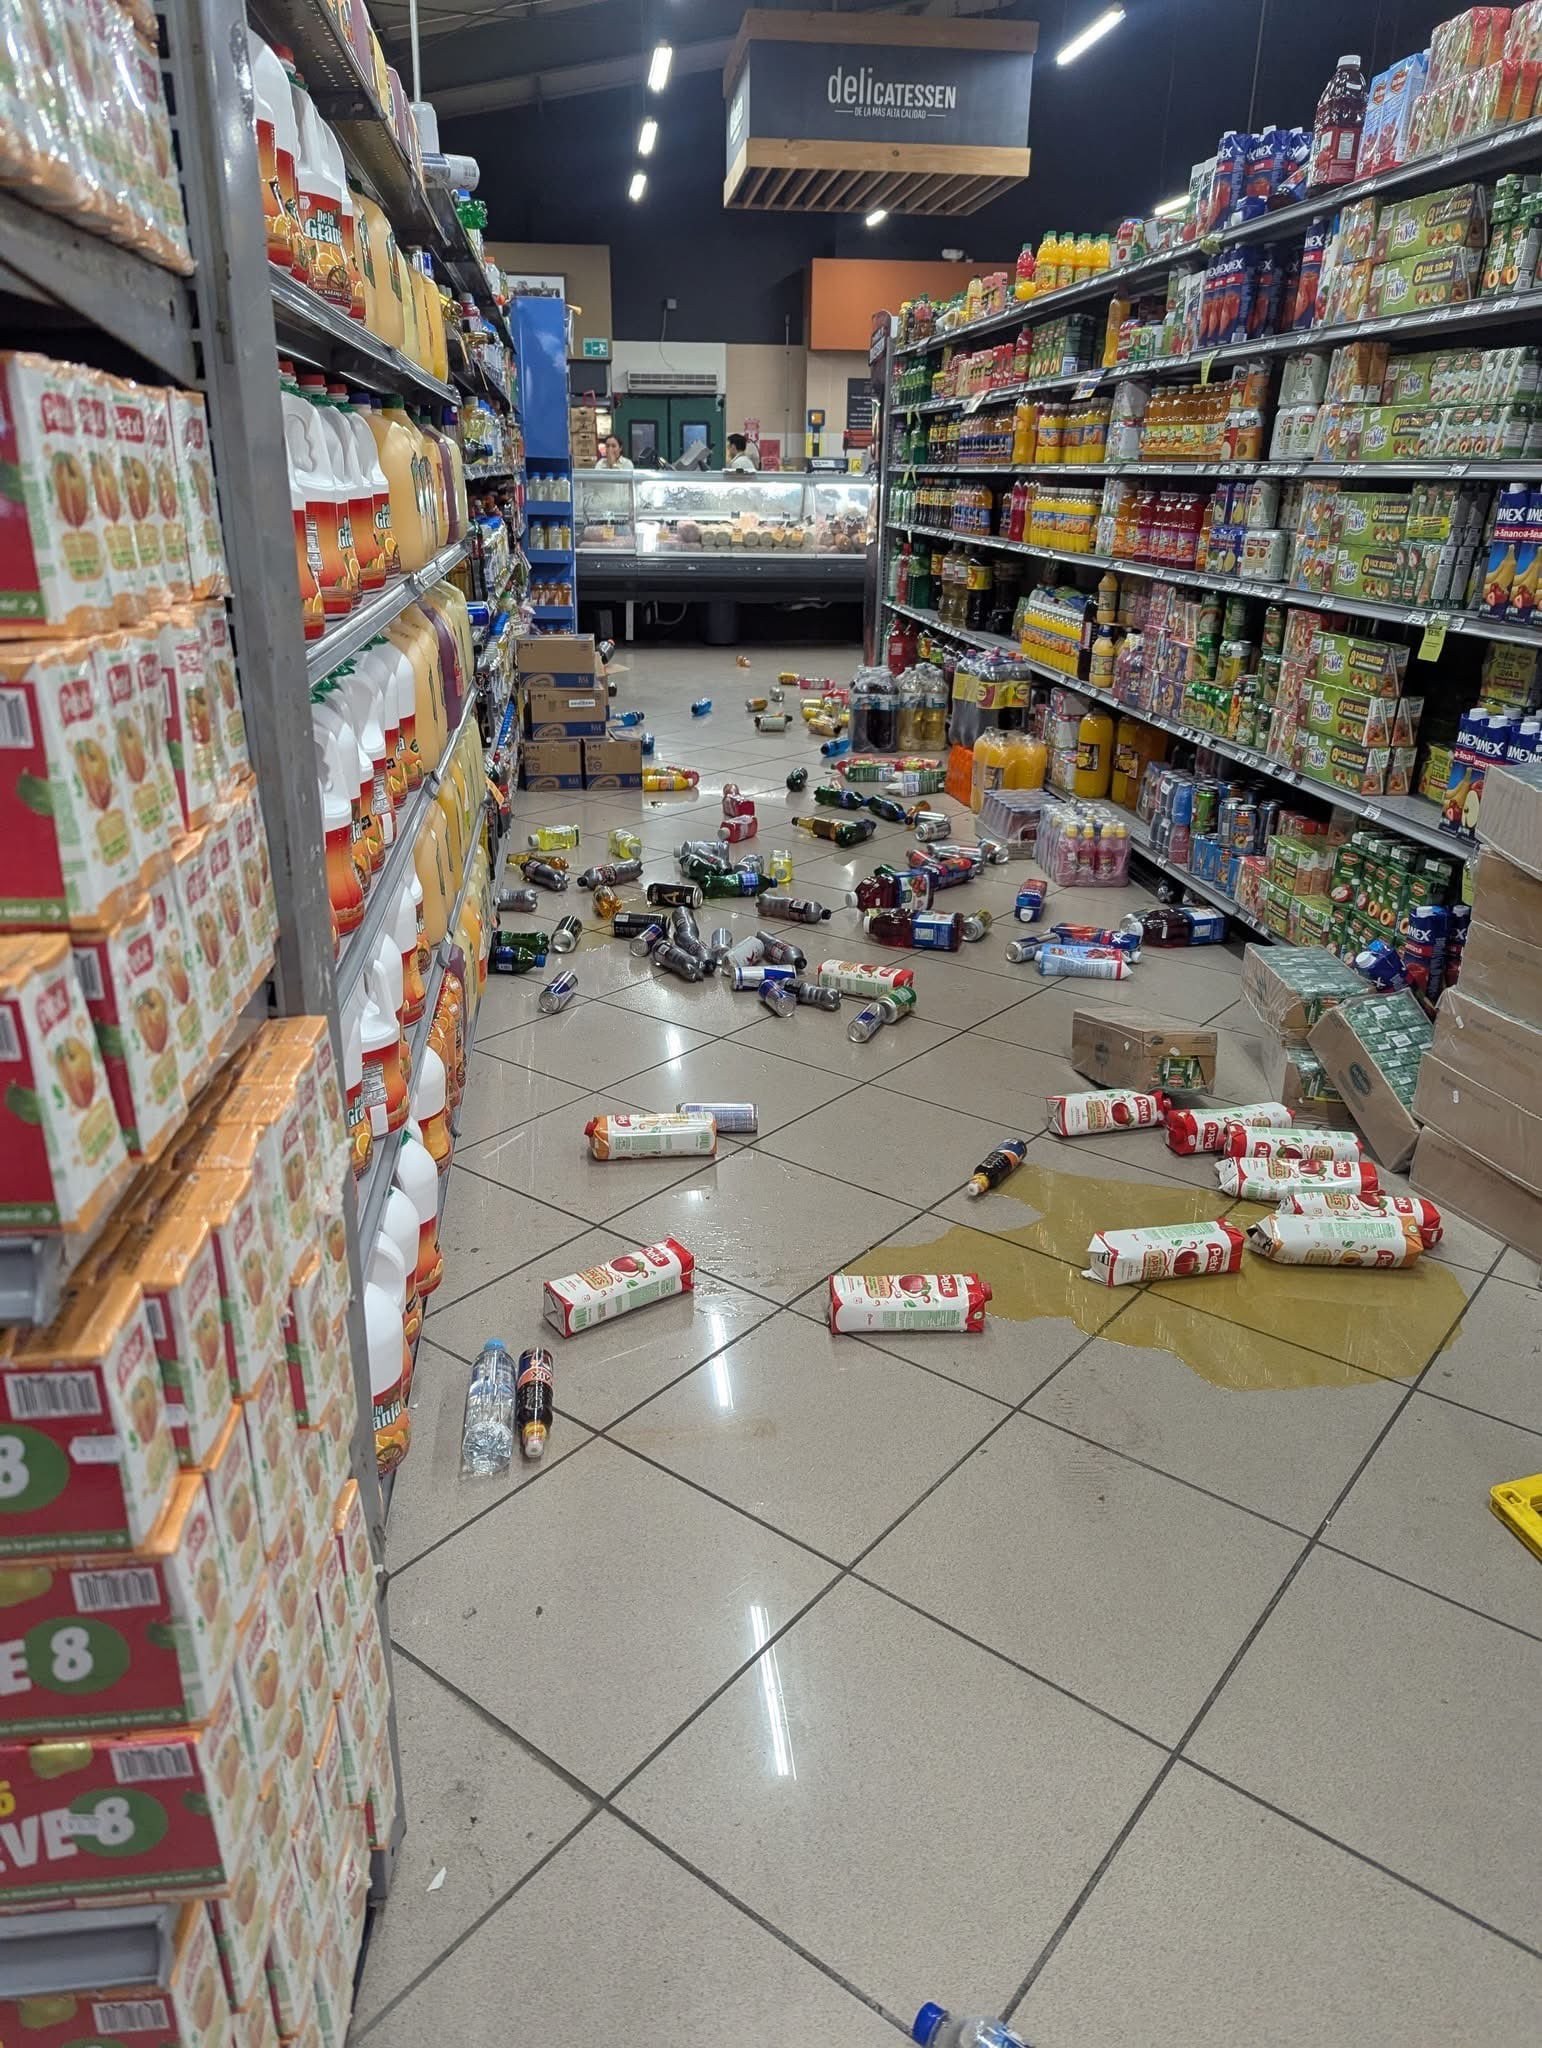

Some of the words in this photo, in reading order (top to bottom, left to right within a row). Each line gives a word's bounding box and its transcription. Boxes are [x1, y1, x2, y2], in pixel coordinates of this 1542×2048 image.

[854, 107, 863, 117] DE
[863, 107, 871, 117] LA
[886, 108, 900, 118] ALTA
[901, 109, 927, 120] CALIDAD
[1137, 1098, 1150, 1123] Petit
[1205, 1122, 1217, 1149] Petit
[645, 1246, 665, 1265] Petit
[373, 1400, 401, 1431] anja
[51, 1626, 94, 1683] 8
[93, 1796, 135, 1846] 8
